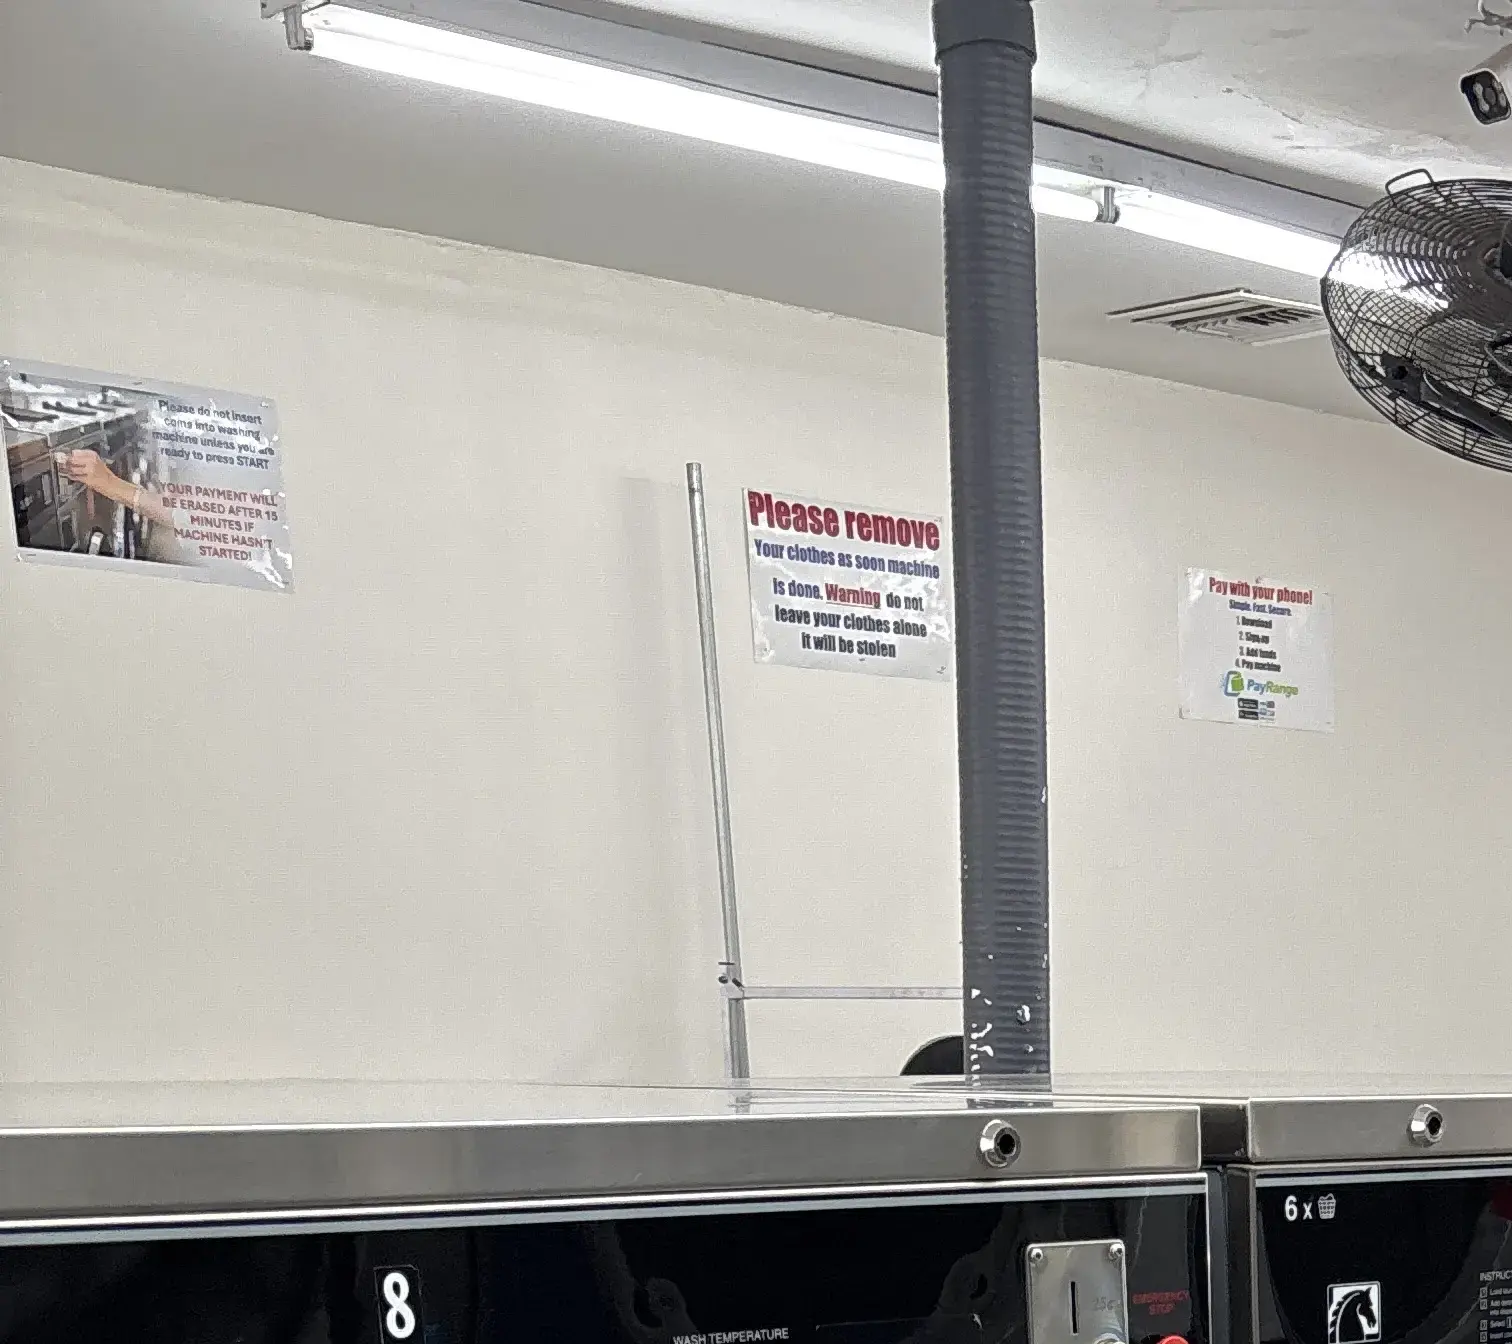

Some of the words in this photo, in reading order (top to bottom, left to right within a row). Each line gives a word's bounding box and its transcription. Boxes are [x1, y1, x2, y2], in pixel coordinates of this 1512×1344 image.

[160, 482, 192, 495] YOUR
[196, 486, 247, 500] PAYMENT
[250, 493, 278, 506] WILL
[163, 497, 176, 508] BE
[180, 499, 225, 515] ERASED
[228, 506, 262, 519] AFTER
[265, 511, 278, 521] 15
[748, 490, 839, 537] Please
[844, 510, 940, 551] remove
[754, 538, 785, 558] Your
[787, 544, 835, 565] clothes
[838, 553, 853, 567] as
[855, 554, 885, 572] soon
[888, 558, 939, 579] machine
[773, 578, 785, 595] is
[789, 579, 823, 600] done.
[825, 583, 881, 609] Warning
[886, 592, 901, 607] do
[904, 596, 924, 611] not
[1209, 577, 1227, 595] Pay
[1230, 581, 1250, 597] with
[1252, 585, 1275, 600] your
[1277, 587, 1313, 605] phone!
[383, 1271, 416, 1339] 8
[708, 1328, 790, 1344] TEMPERATURE
